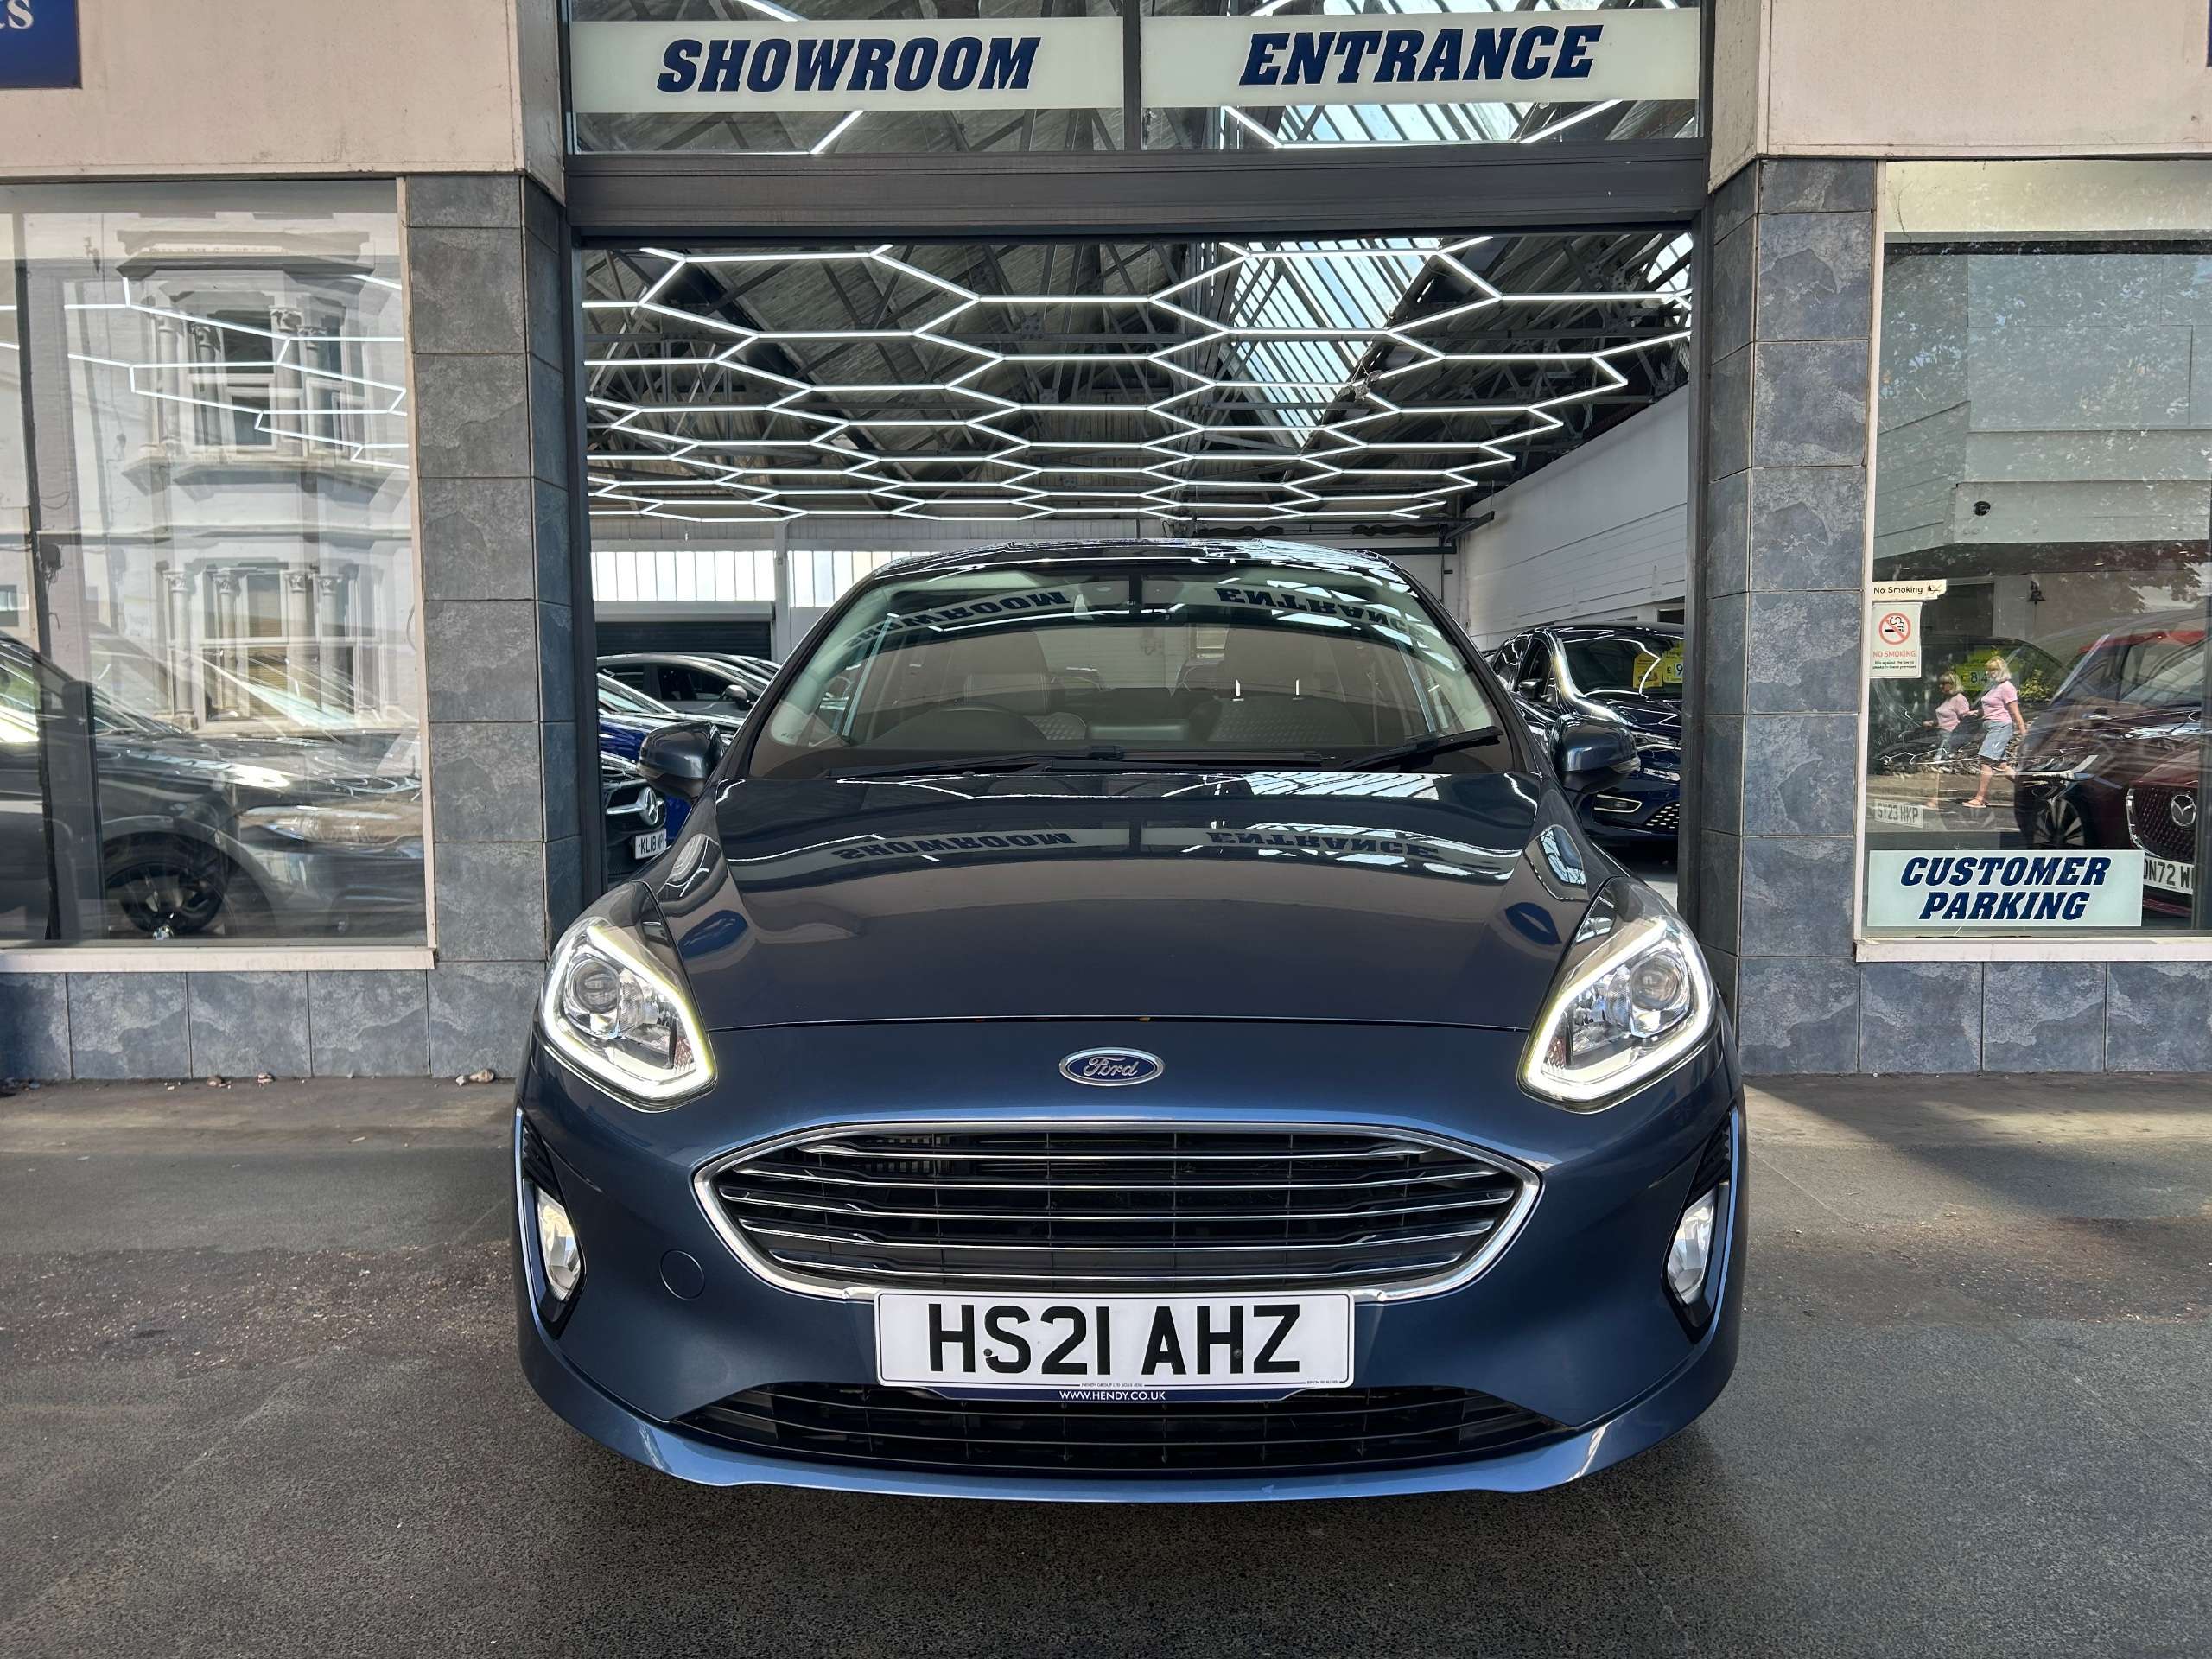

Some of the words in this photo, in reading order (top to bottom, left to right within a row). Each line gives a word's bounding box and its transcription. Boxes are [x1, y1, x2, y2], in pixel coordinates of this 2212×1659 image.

[656, 37, 1040, 93] SHOWROOM
[1238, 24, 1604, 86] ENTRANCE
[1888, 586, 1923, 594] Smoking
[1901, 804, 1919, 823] HKP
[1901, 856, 2112, 887] CUSTOMER
[1918, 891, 2090, 921] PARKING
[1083, 1056, 1139, 1077] Ford
[928, 1303, 1111, 1376] HS21
[1141, 1304, 1301, 1376] AHZ
[1059, 1390, 1166, 1401] WWW.HENDY.CO.UK
